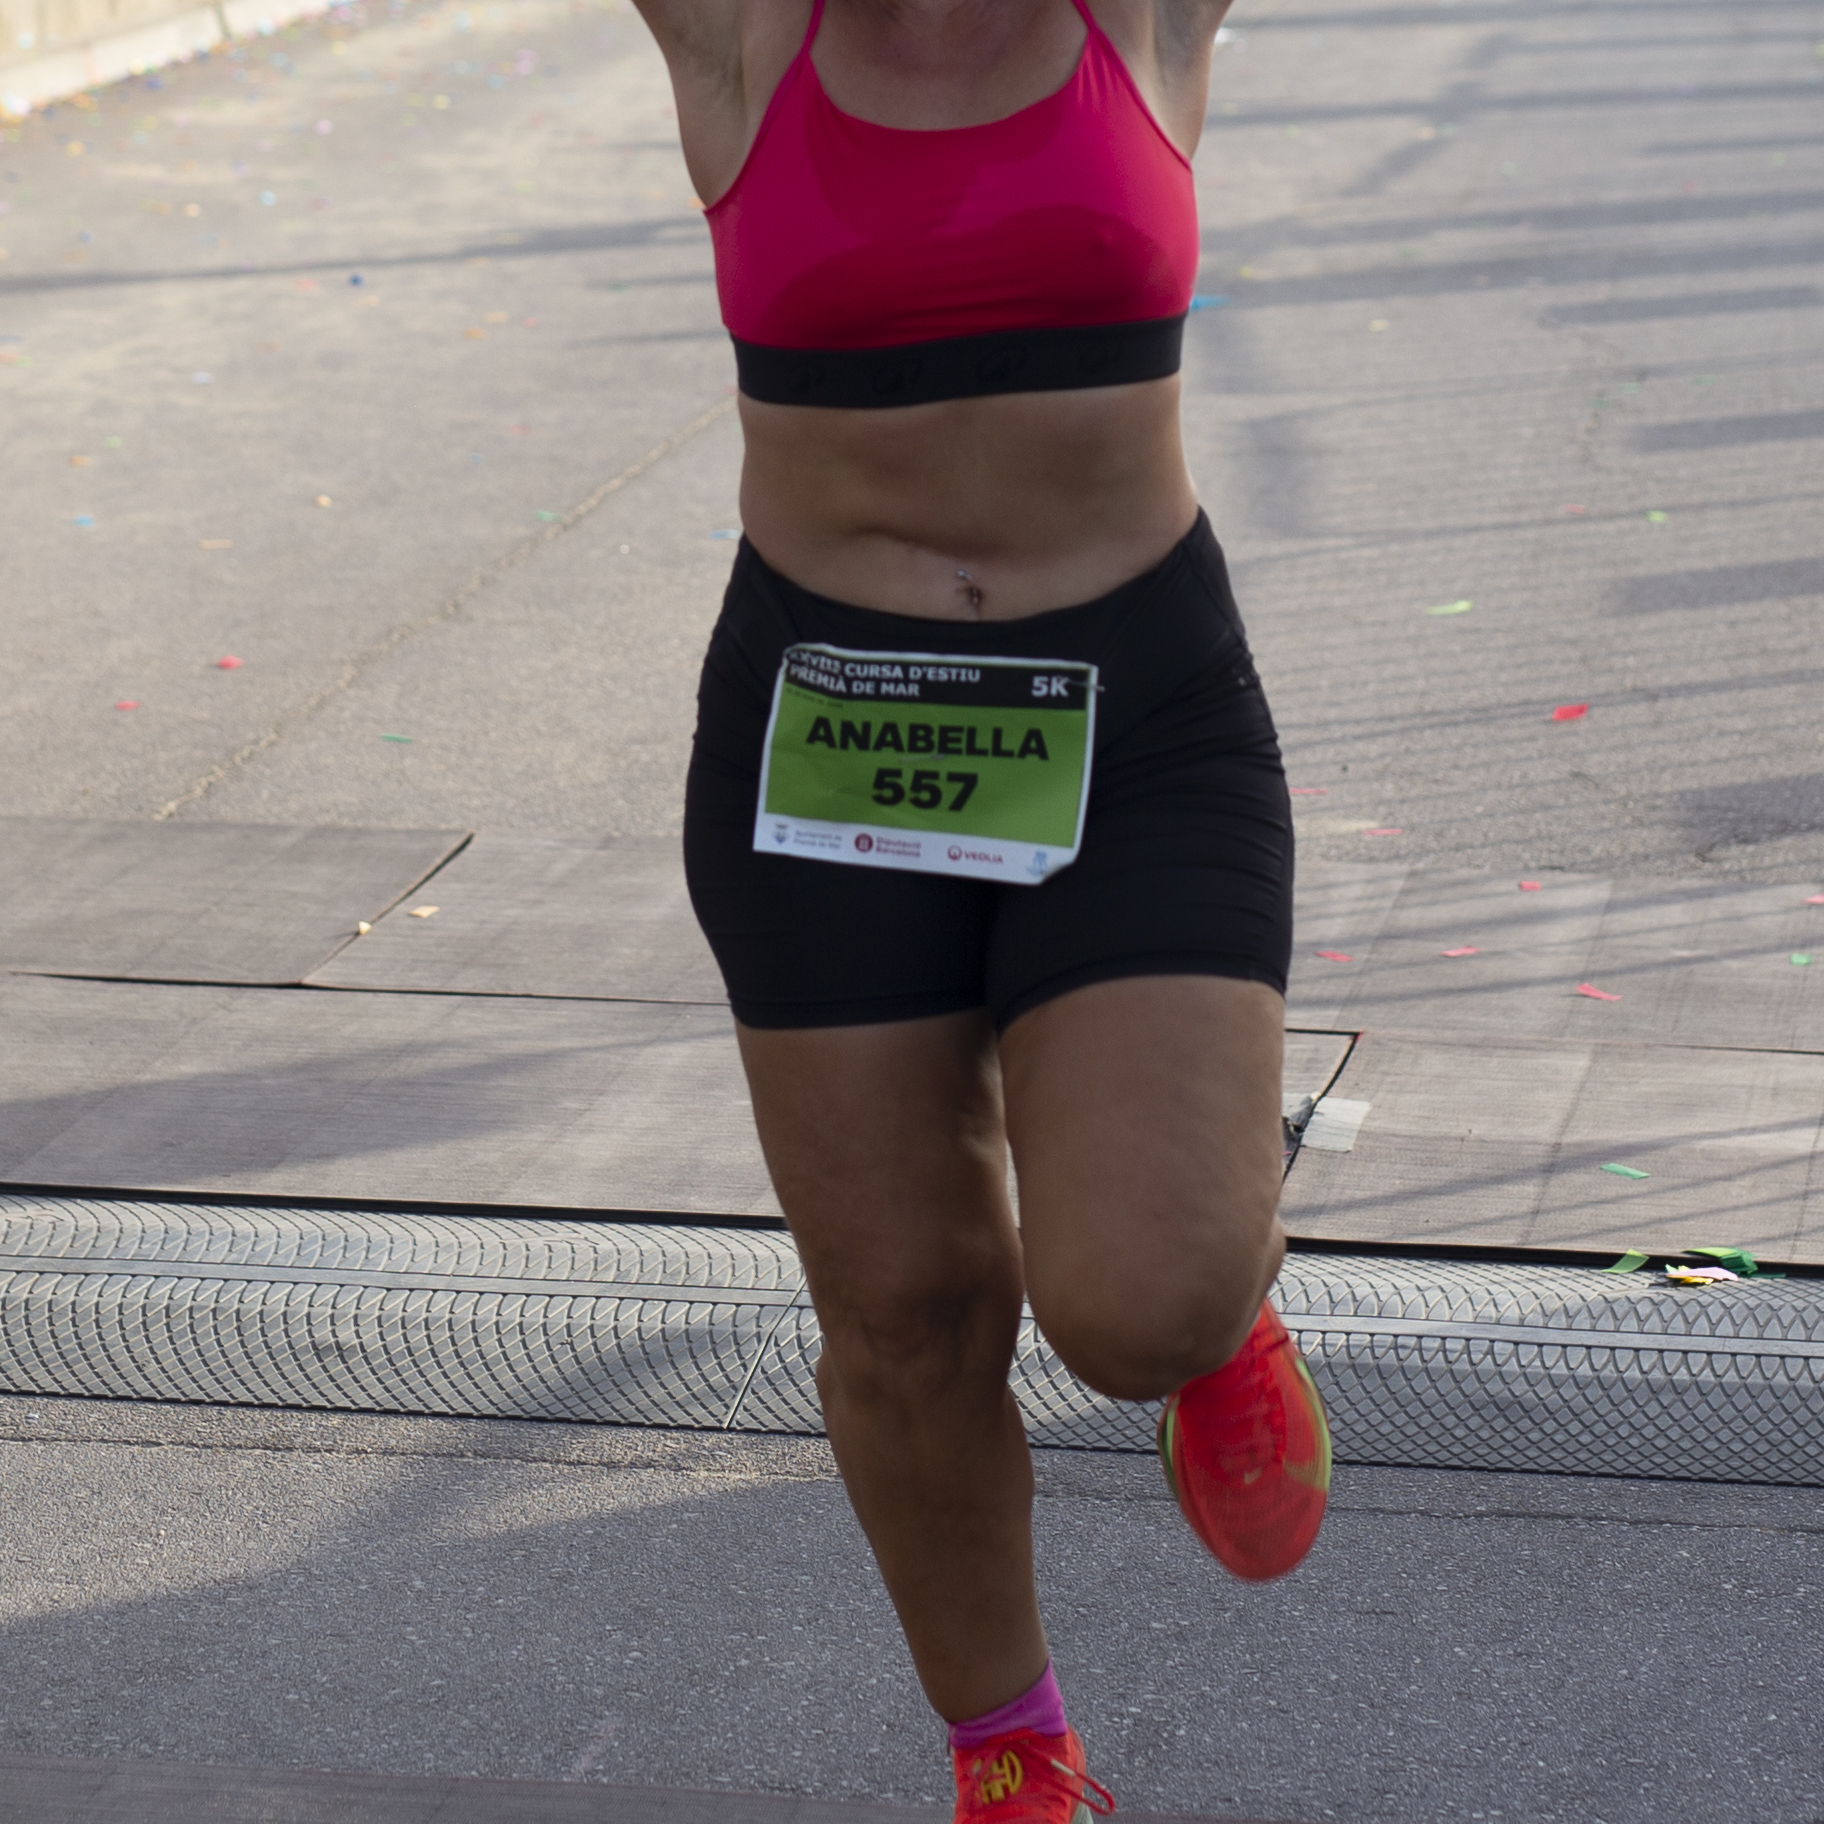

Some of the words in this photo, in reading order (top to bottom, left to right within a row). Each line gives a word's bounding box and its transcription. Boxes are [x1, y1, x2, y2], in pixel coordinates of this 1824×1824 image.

[844, 663, 904, 680] CURSA
[909, 665, 981, 683] D'ESTIU
[851, 680, 876, 695] DE
[880, 682, 920, 697] MAR
[1031, 676, 1069, 697] 5K
[806, 716, 1049, 760] ANABELLA
[872, 768, 979, 812] 557
